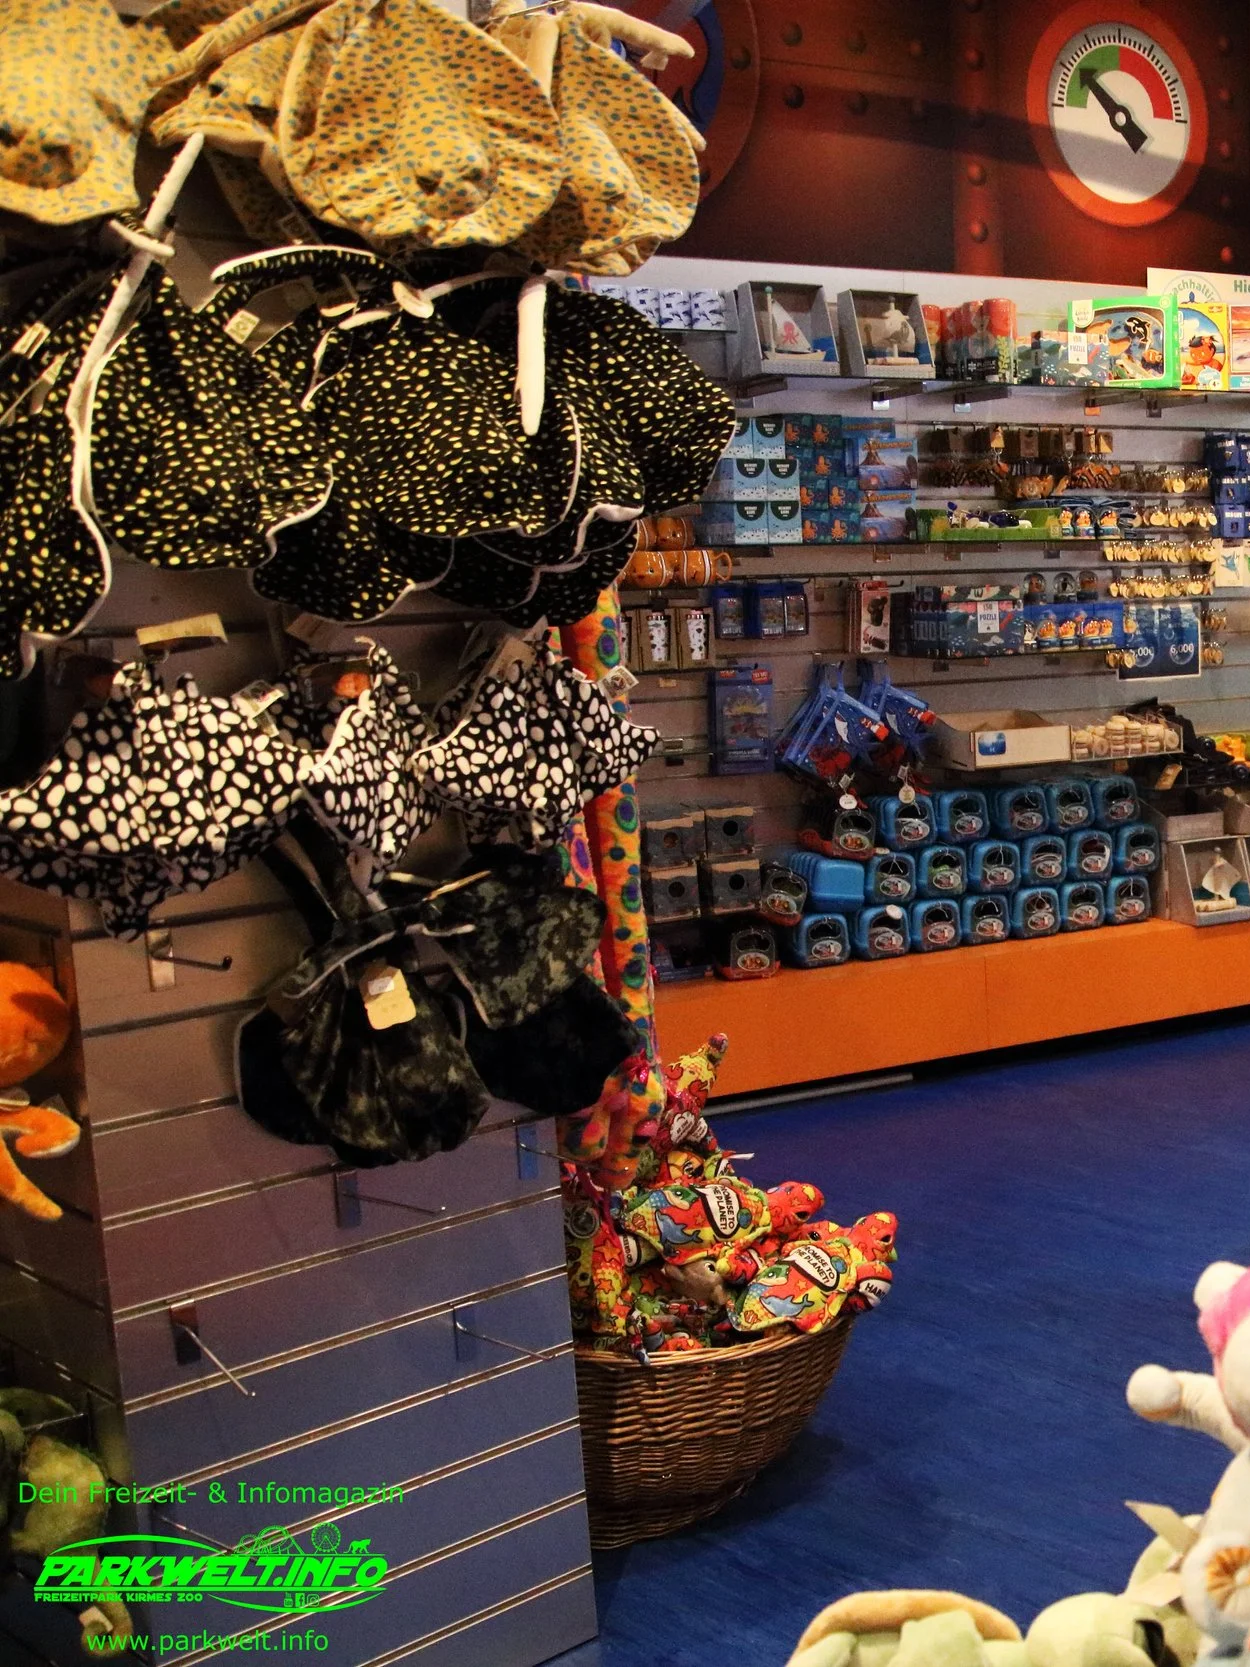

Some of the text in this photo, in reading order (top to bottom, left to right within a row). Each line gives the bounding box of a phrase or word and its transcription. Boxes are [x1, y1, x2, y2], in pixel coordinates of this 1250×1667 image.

[716, 1195, 728, 1230] PLANET!
[721, 1186, 735, 1229] ROMISE TO
[804, 1246, 835, 1280] ROMISE TO
[804, 1254, 830, 1284] PLANET!
